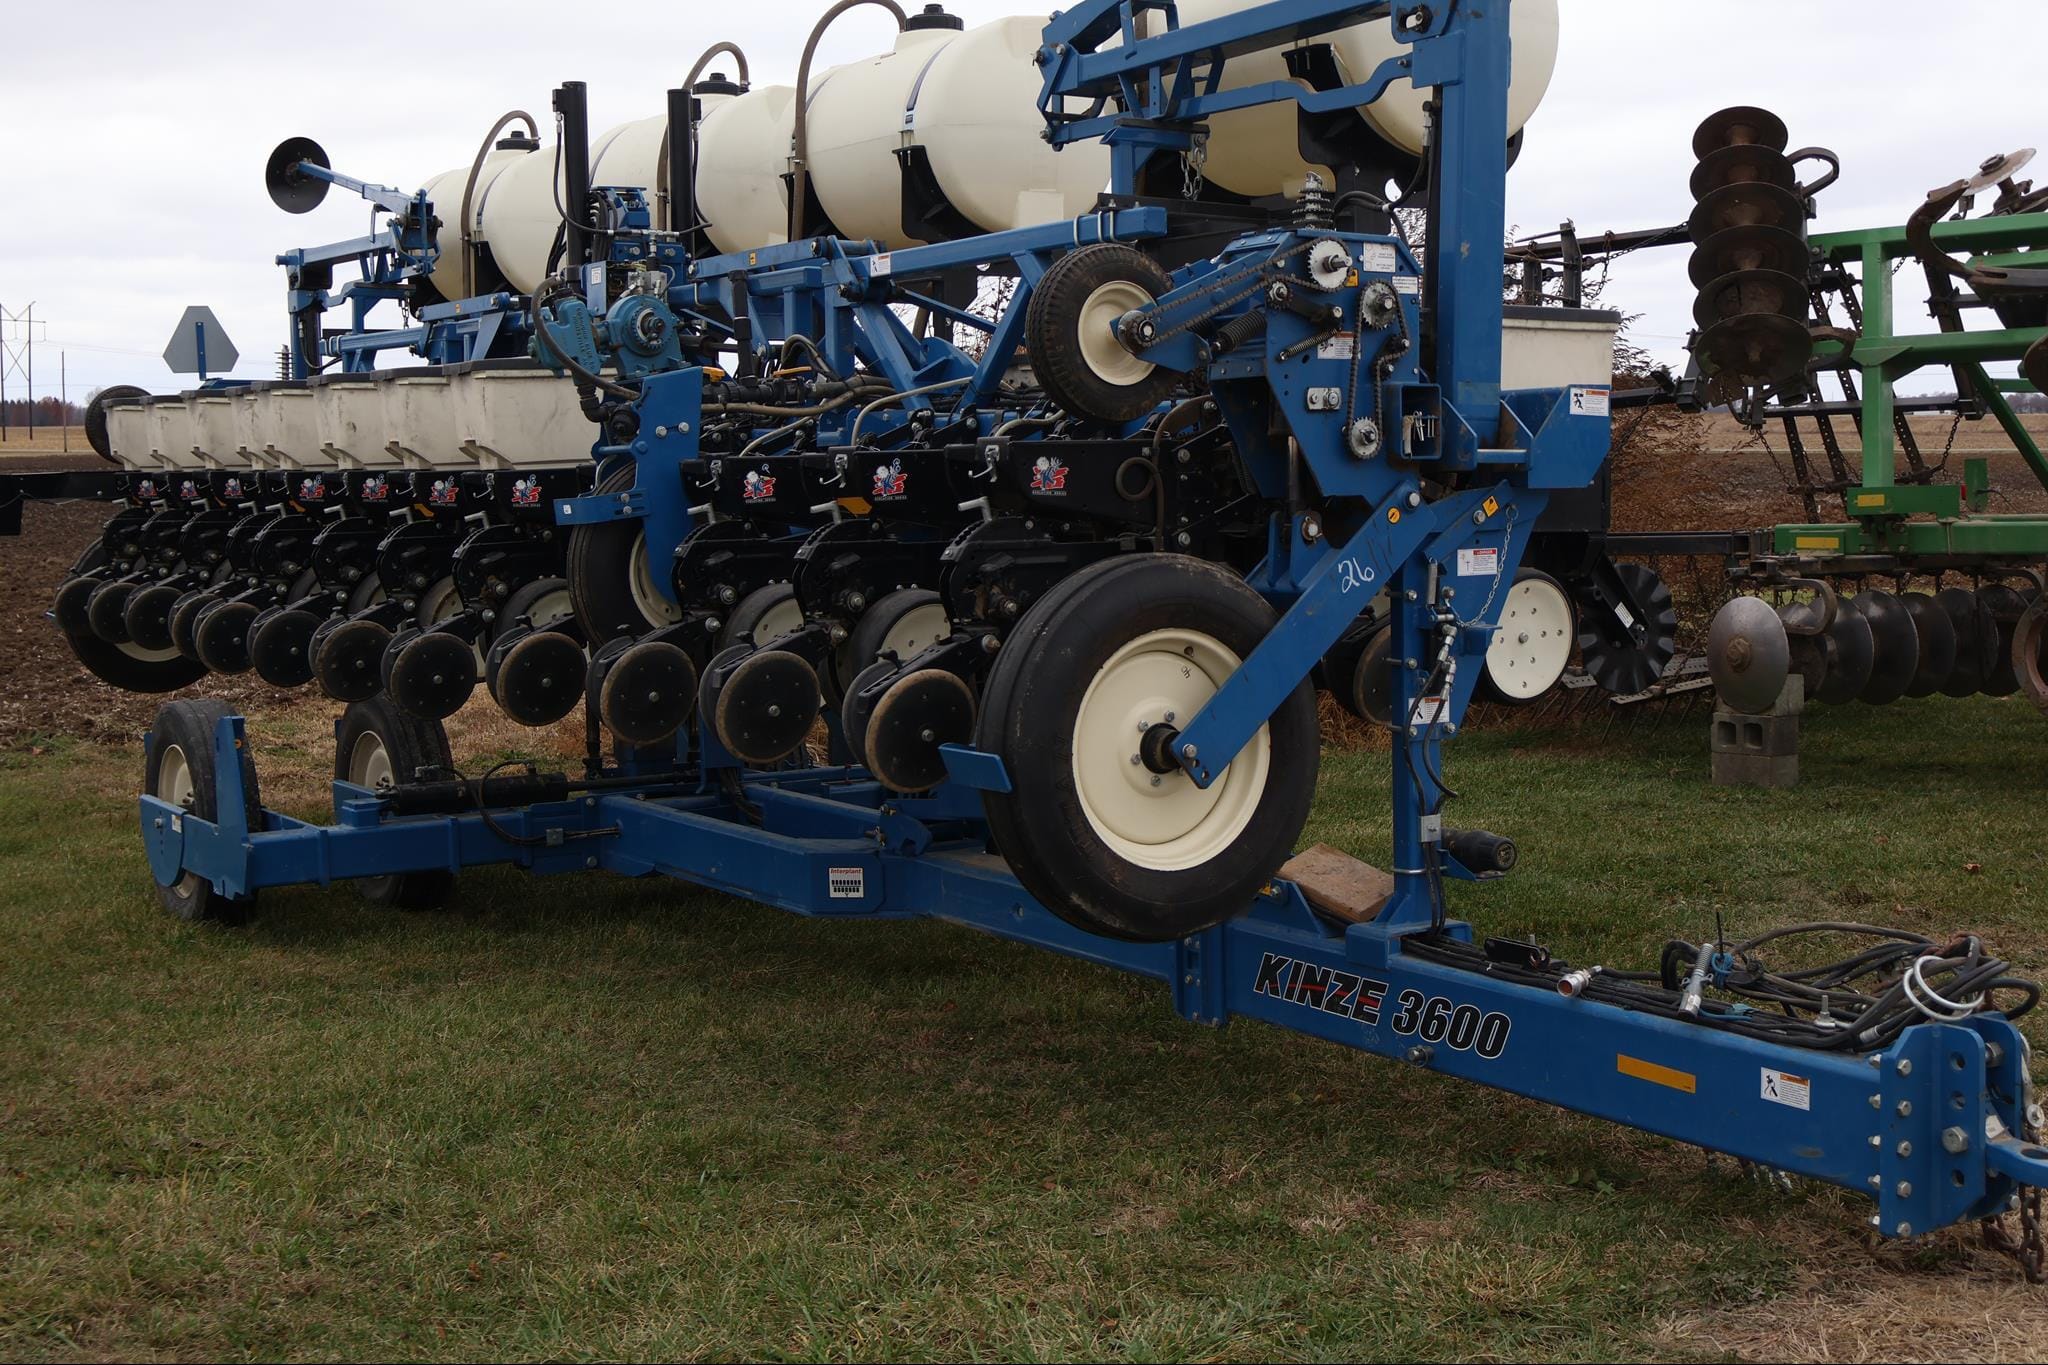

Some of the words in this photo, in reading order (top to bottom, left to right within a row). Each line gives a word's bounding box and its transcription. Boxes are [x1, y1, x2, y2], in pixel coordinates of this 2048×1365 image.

[1338, 557, 1375, 594] 26
[1253, 952, 1389, 1025] KINZE
[1392, 989, 1511, 1059] 3600
